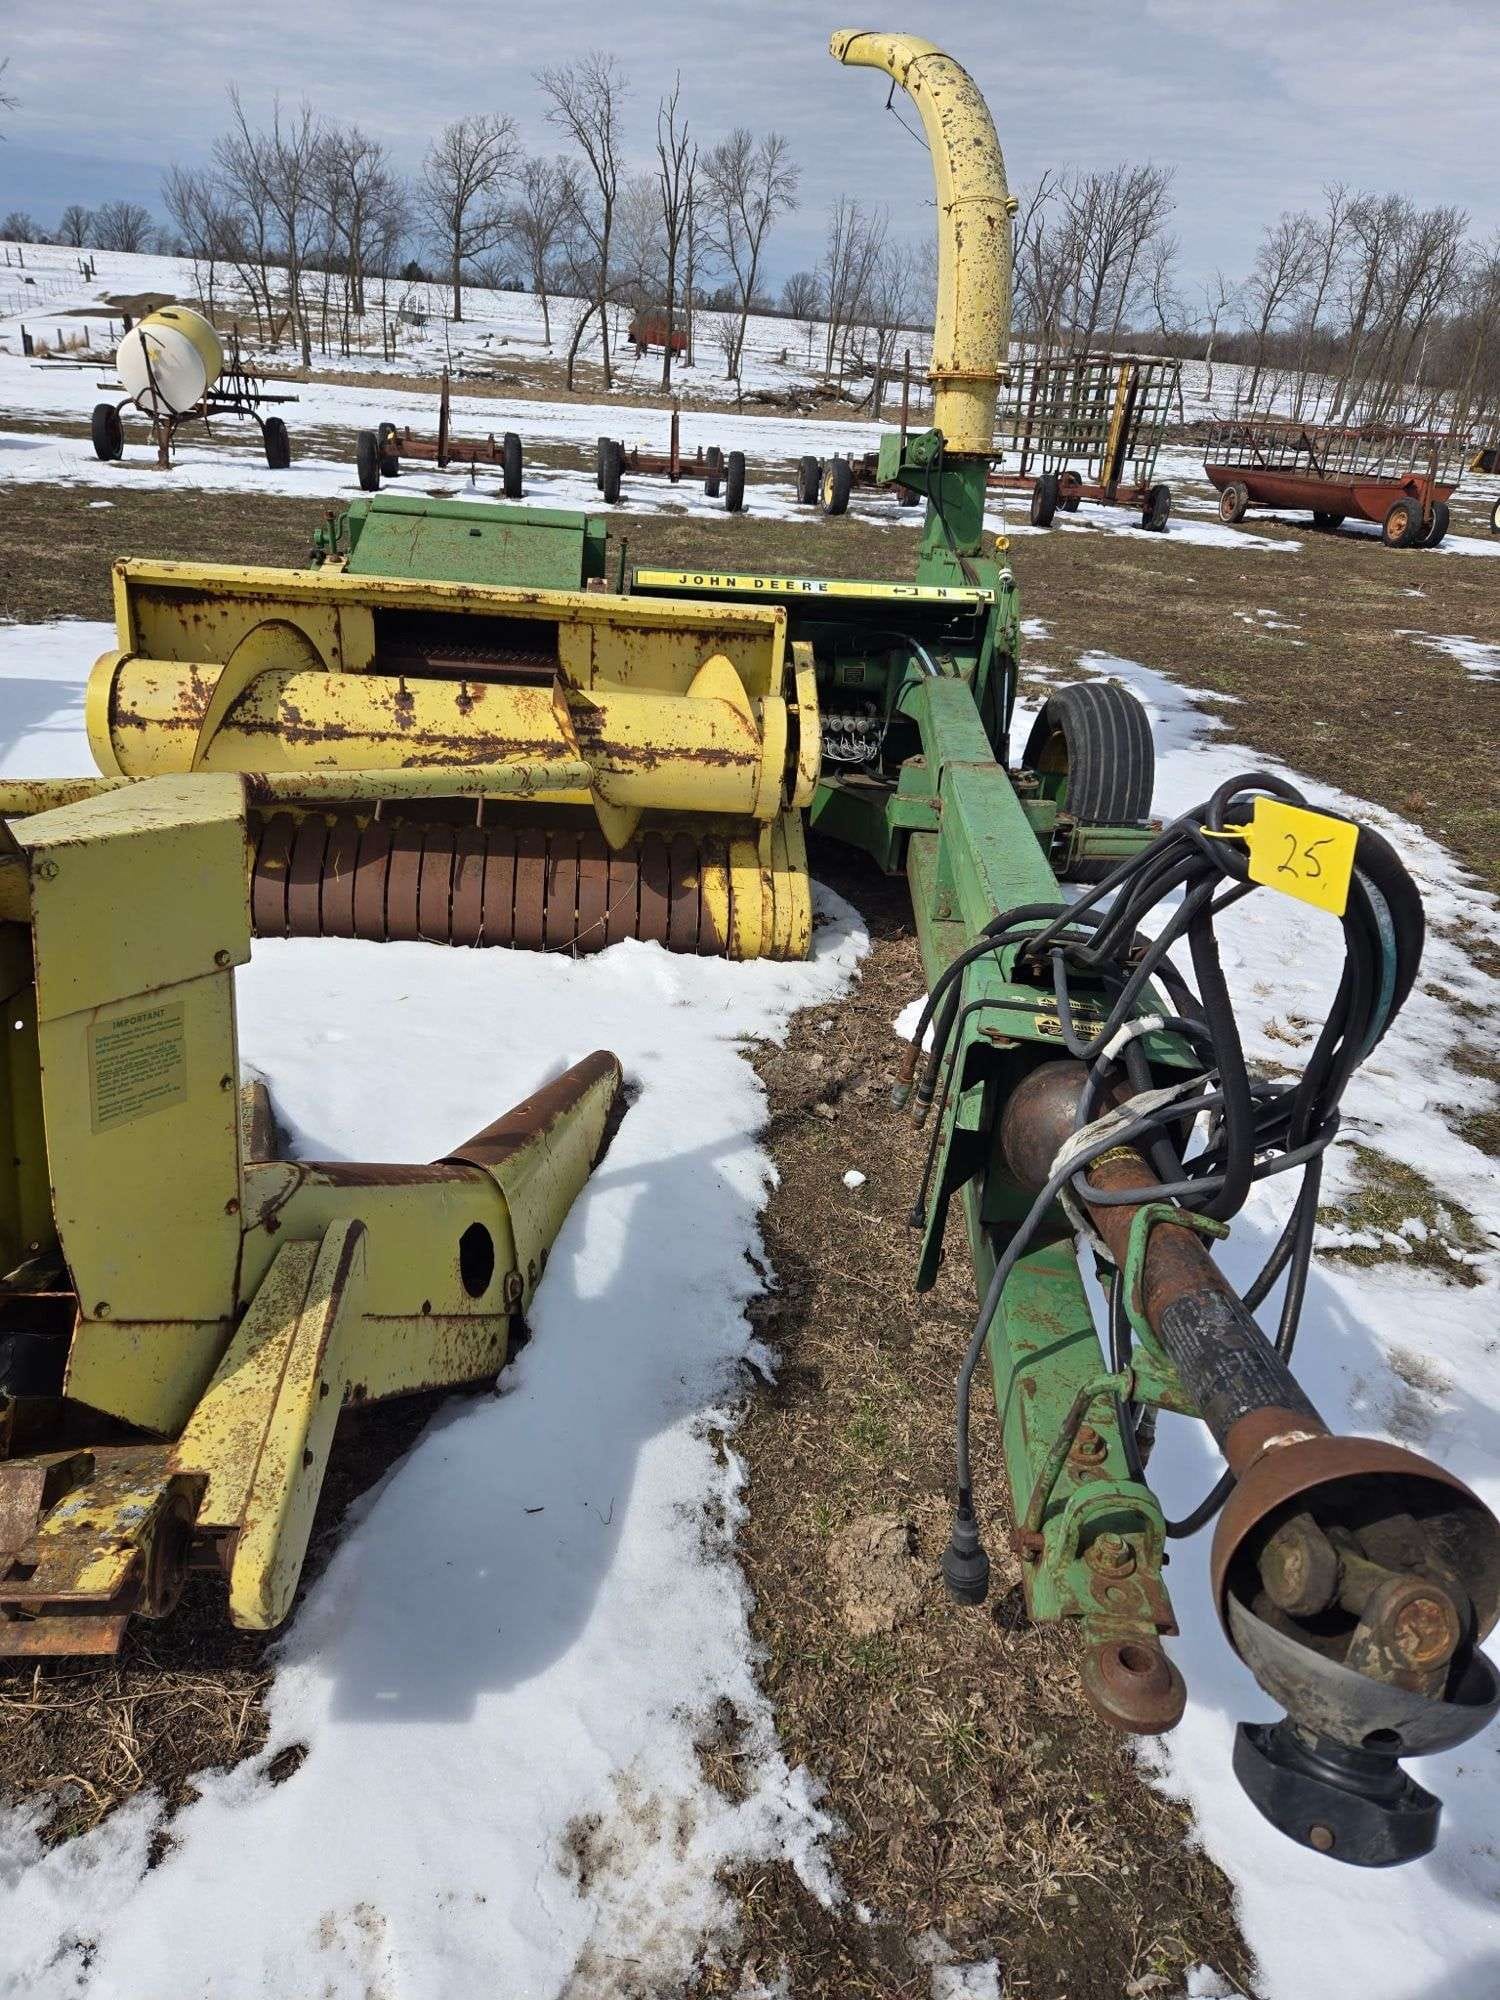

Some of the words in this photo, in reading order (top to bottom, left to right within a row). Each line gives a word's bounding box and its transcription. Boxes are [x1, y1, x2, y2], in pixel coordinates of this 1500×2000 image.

[679, 575, 736, 587] JOHN
[754, 579, 828, 592] DEERE
[937, 588, 947, 597] N
[1277, 833, 1336, 878] 25
[112, 1009, 166, 1030] IMPORTANT
